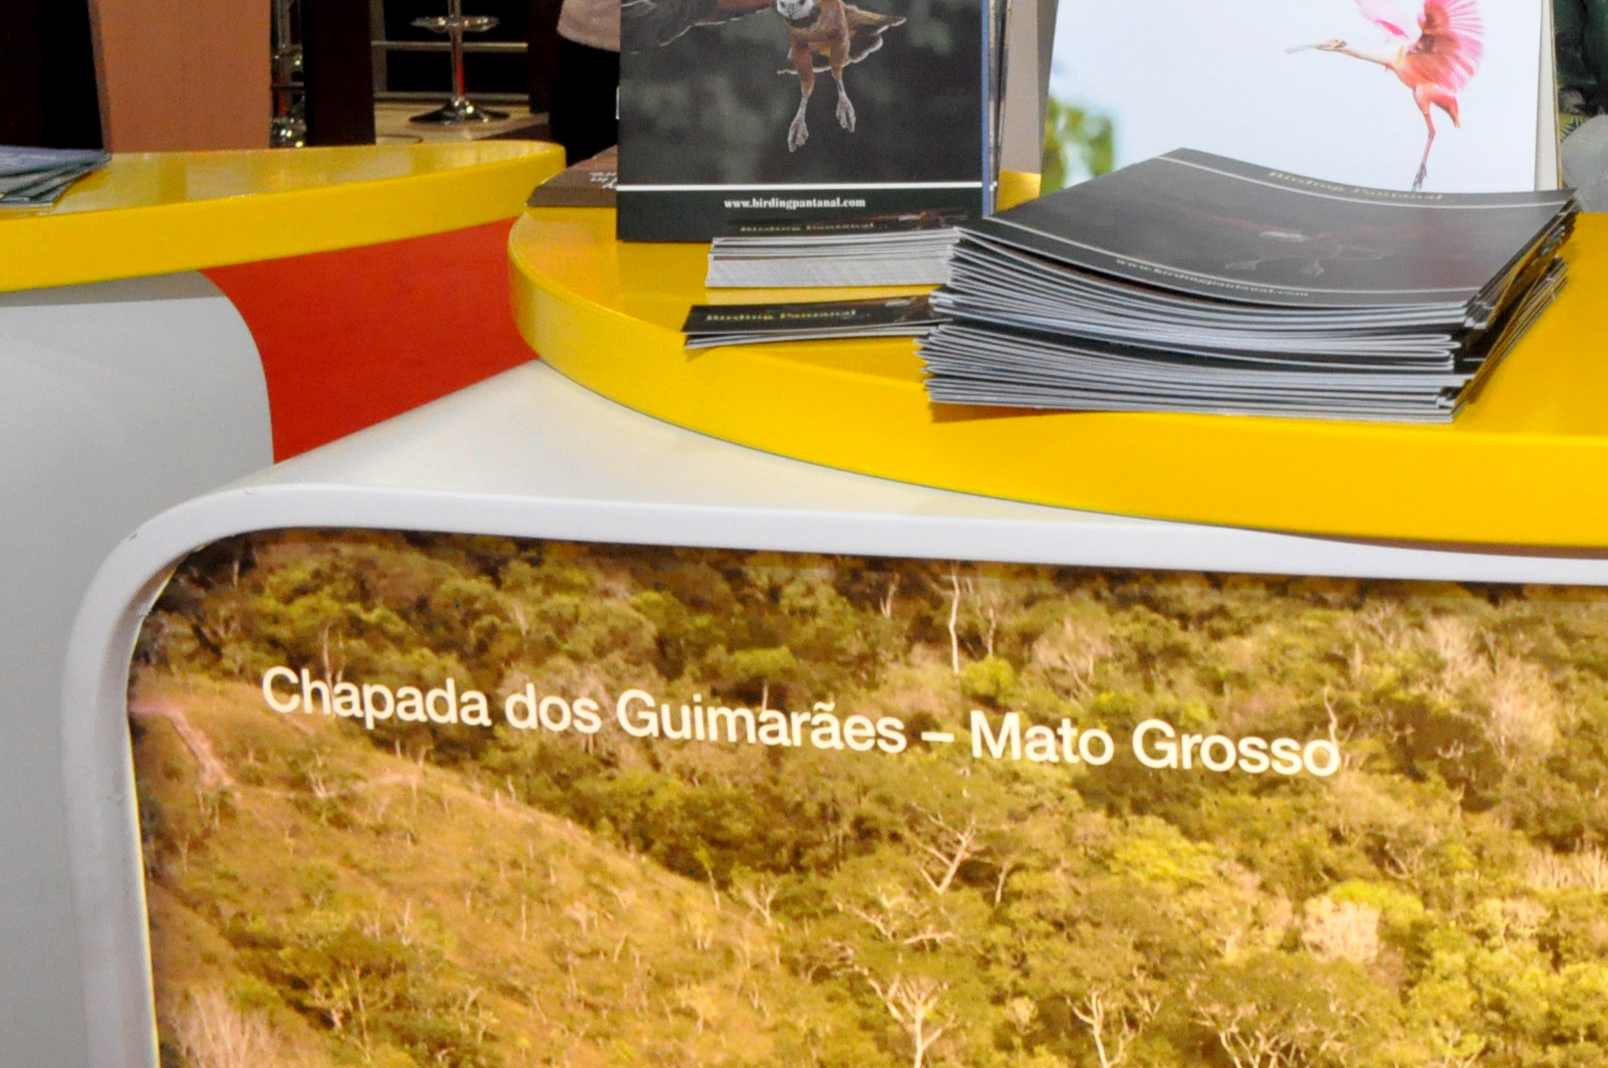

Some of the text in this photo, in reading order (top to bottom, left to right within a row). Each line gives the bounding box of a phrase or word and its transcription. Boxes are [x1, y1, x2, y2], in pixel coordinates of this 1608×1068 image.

[723, 197, 867, 210] www.birdingpantanal.com
[261, 666, 491, 729] Chapada
[505, 683, 602, 734] dos
[616, 689, 907, 754] Guimarães
[970, 710, 1115, 766] Mato
[1132, 719, 1342, 777] Grosso
